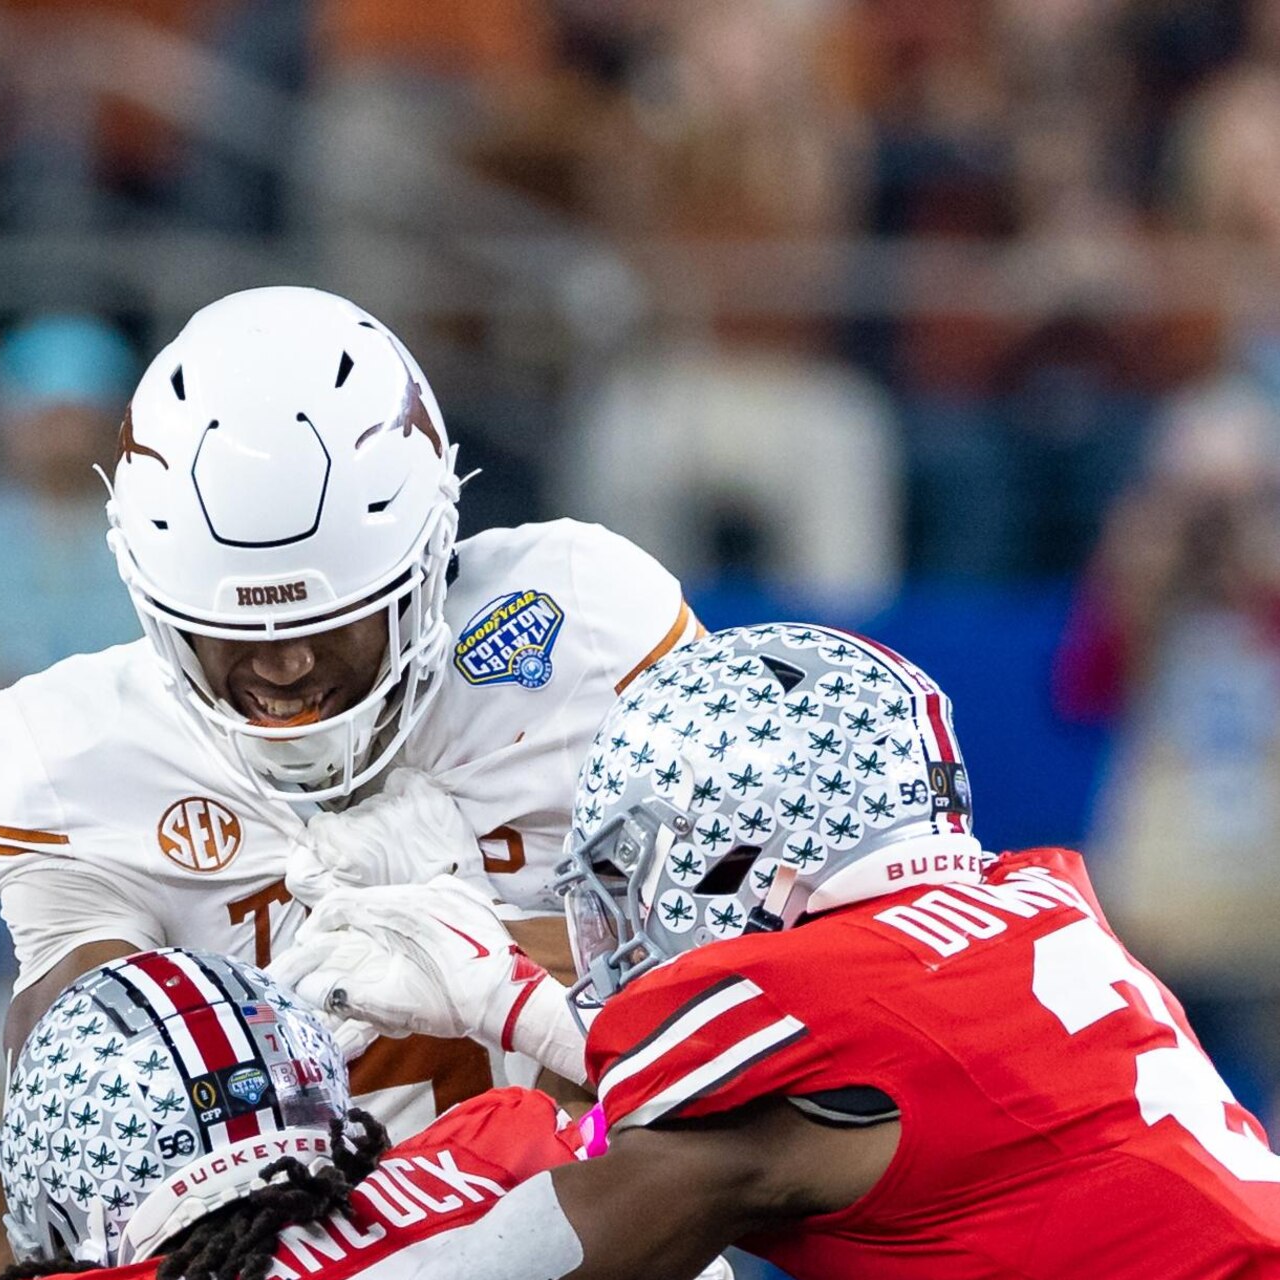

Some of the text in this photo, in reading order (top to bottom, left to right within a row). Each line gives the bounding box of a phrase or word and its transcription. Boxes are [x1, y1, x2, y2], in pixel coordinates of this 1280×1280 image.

[236, 581, 308, 606] HORNS
[456, 591, 536, 655] GOODYEAR
[462, 599, 557, 676] COTTON
[487, 625, 545, 672] BOWL
[161, 800, 237, 869] SEC
[886, 854, 984, 881] BUCKE
[264, 1034, 279, 1052] 7
[200, 1108, 223, 1122] CFP
[157, 1129, 196, 1160] 50
[171, 1137, 326, 1197] BUCKEYES
